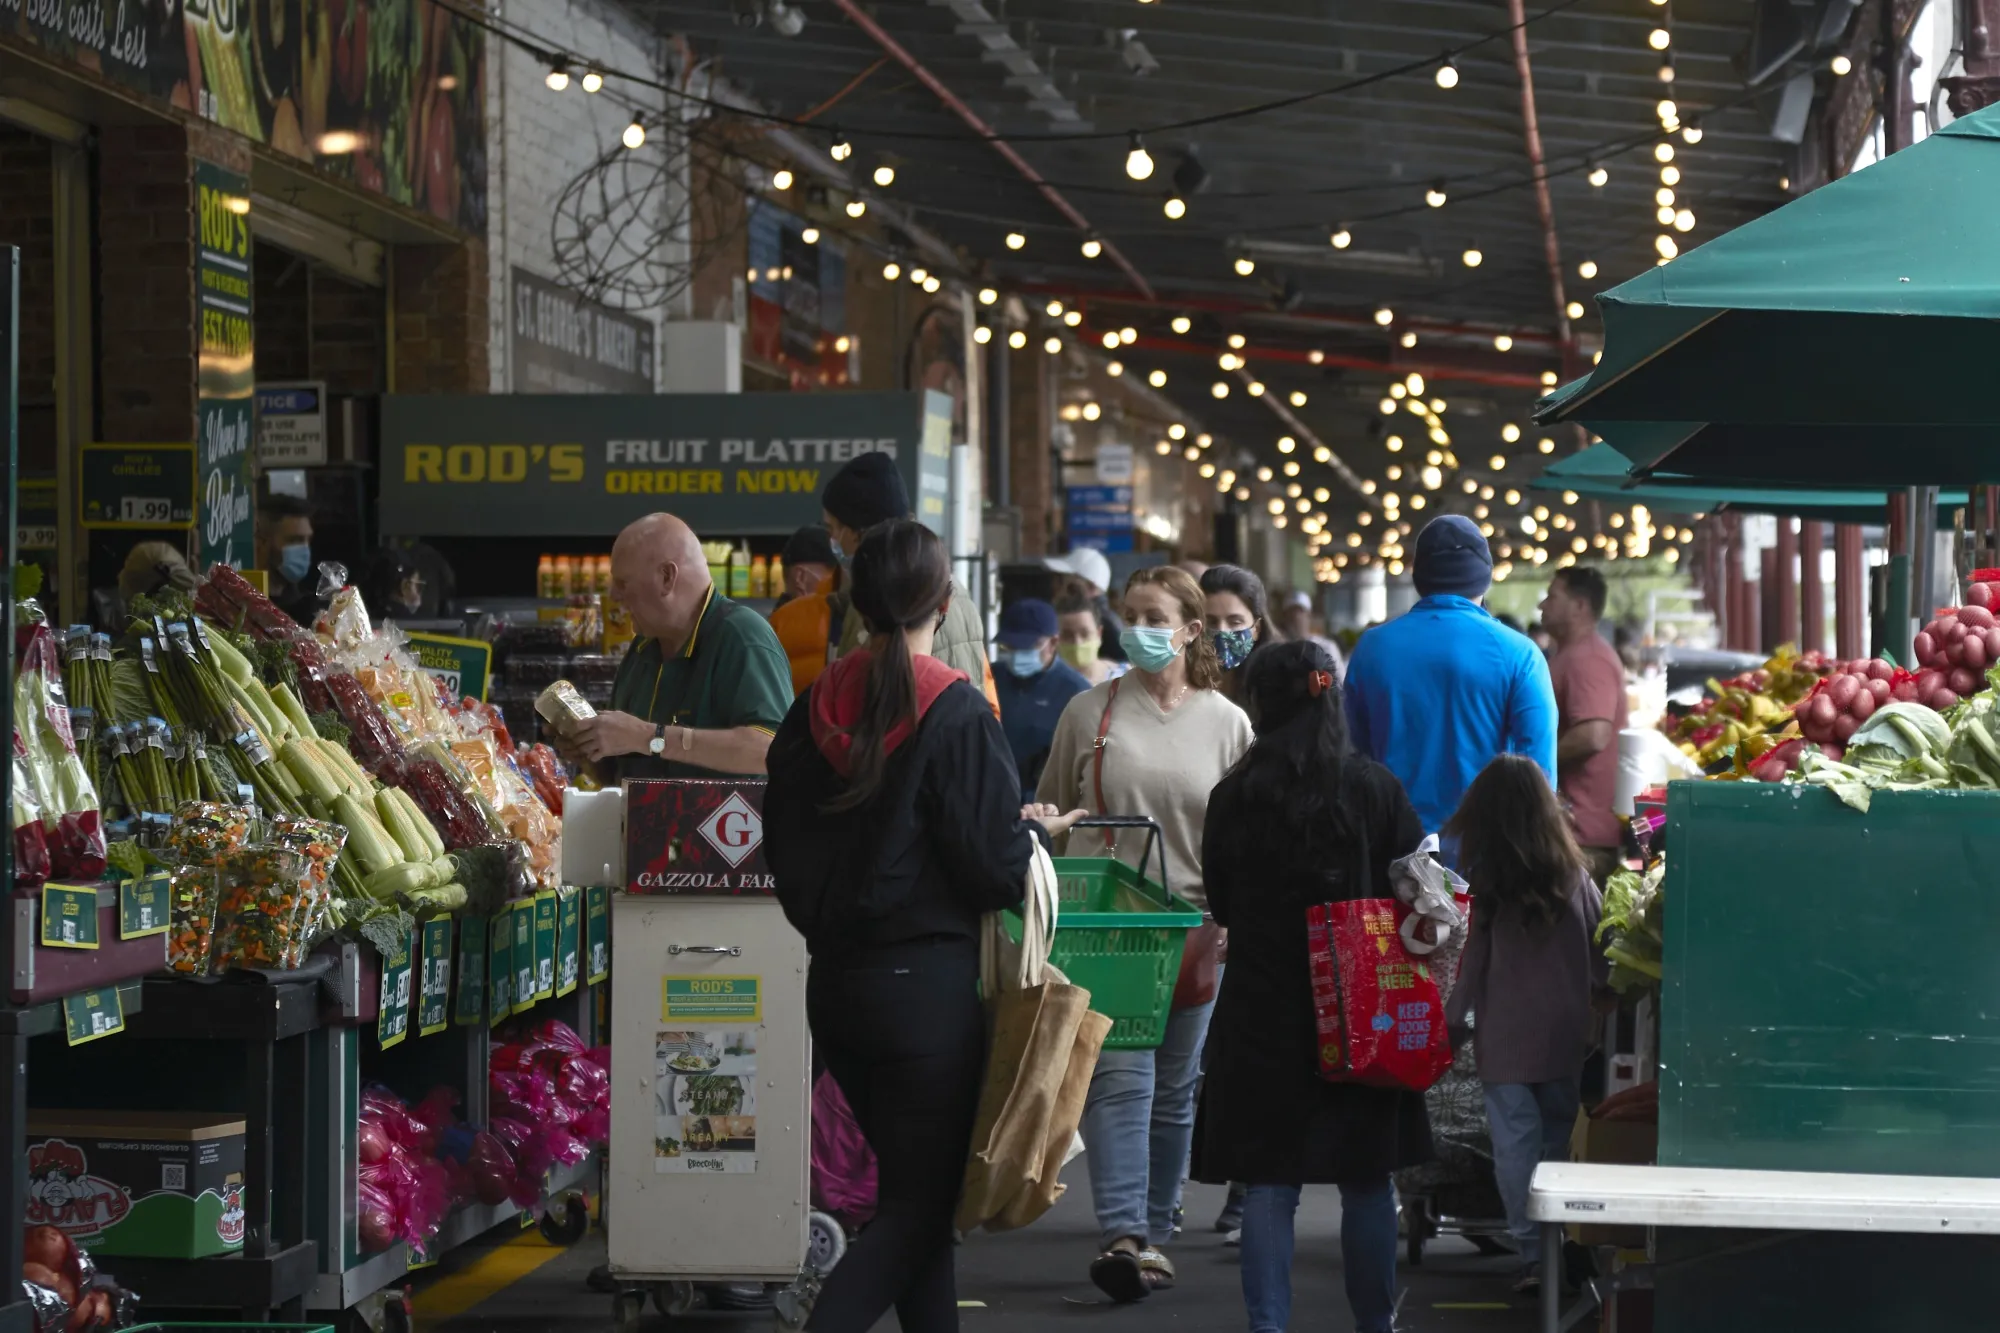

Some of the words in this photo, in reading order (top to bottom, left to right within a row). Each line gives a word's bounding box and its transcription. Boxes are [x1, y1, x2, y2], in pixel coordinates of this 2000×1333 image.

[68, 2, 106, 50] costs
[110, 0, 147, 69] Less
[606, 439, 709, 463] FRUIT
[720, 438, 898, 463] PLATTERS
[404, 444, 585, 483] ROD'S
[605, 469, 723, 494] ORDER
[736, 469, 820, 493] NOW
[125, 501, 169, 520] 1.99
[715, 811, 754, 847] G
[637, 872, 730, 888] GAZZOLA
[1364, 922, 1397, 935] HERE
[690, 980, 735, 994] ROD'S
[1378, 974, 1415, 990] HERE
[1398, 1002, 1430, 1019] KEEP
[1398, 1020, 1431, 1034] BOOKS
[1398, 1034, 1430, 1051] HERE
[681, 1091, 729, 1100] STEAMY
